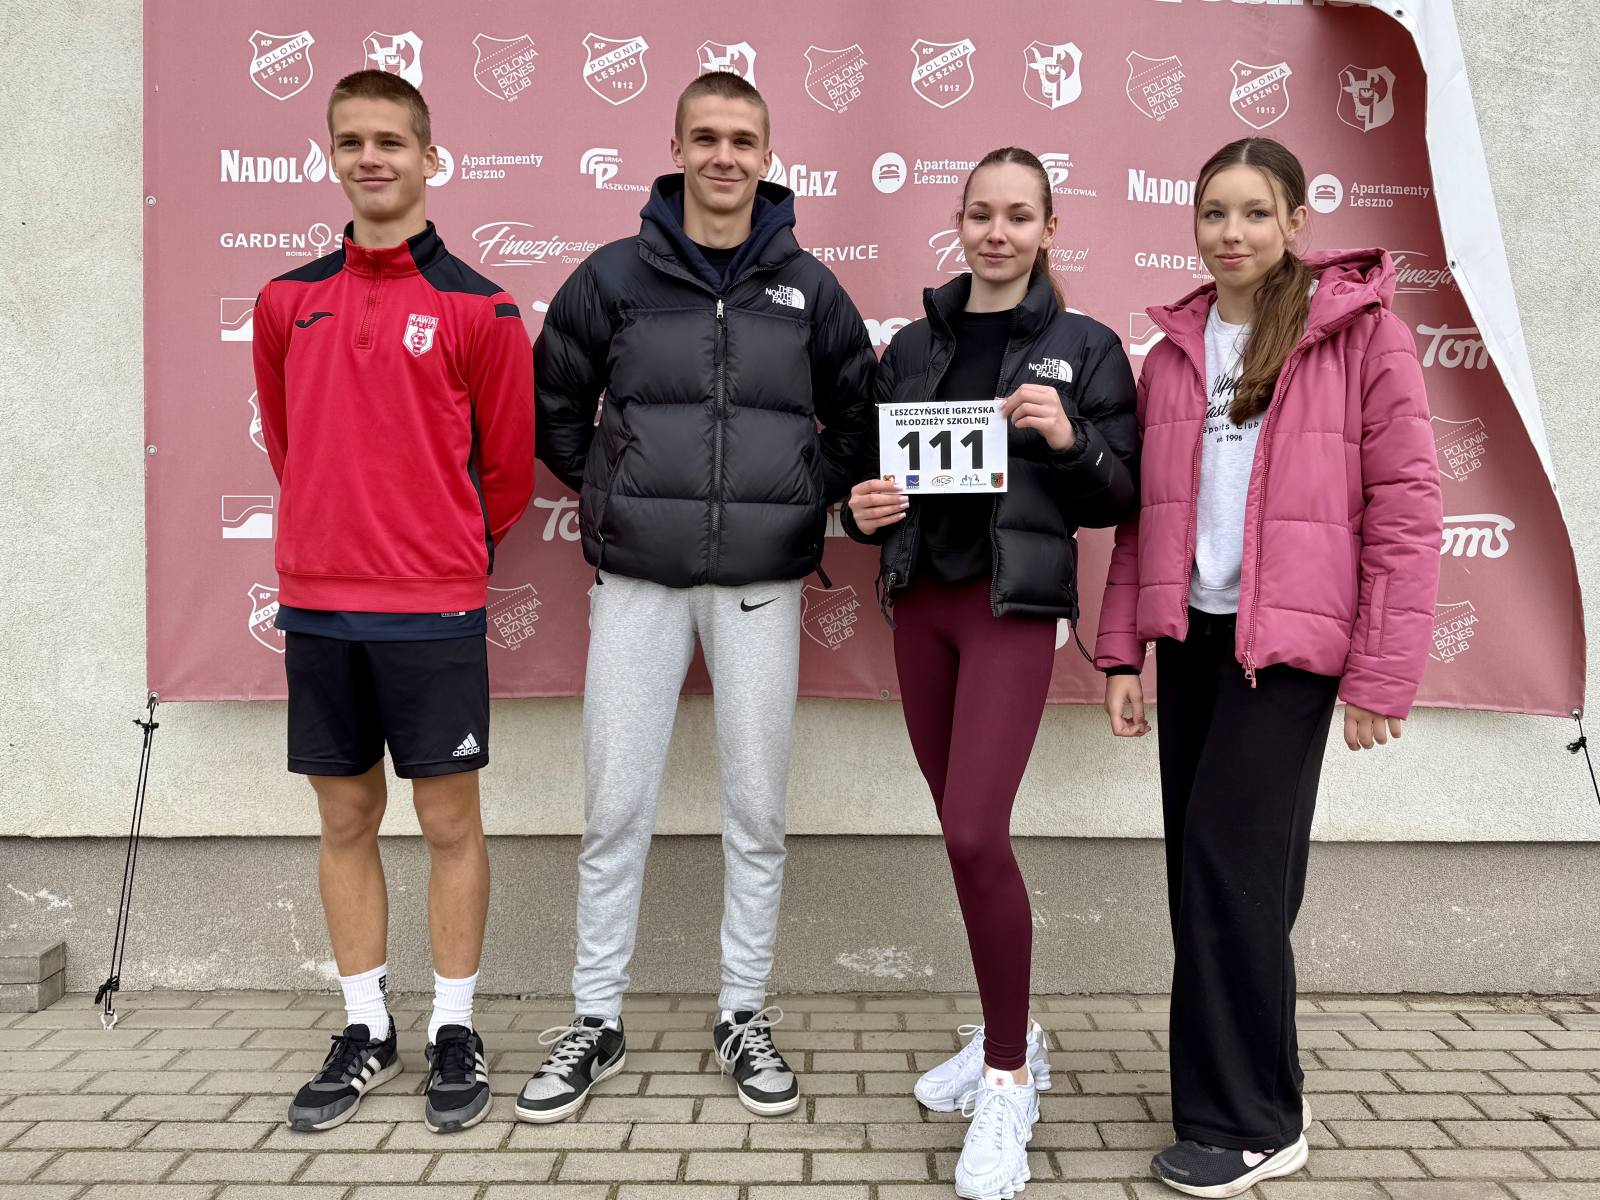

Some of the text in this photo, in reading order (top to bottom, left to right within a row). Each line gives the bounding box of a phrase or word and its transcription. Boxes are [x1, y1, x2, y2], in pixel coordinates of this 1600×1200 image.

[256, 36, 309, 69] POLONIA
[589, 41, 643, 72] POLONIA
[917, 44, 970, 77] POLONIA
[922, 47, 934, 55] KP
[260, 52, 303, 80] LESZNO
[491, 49, 539, 80] POLONIA
[594, 57, 636, 83] LESZNO
[822, 58, 868, 91] POLONIA
[921, 60, 964, 88] LESZNO
[1240, 69, 1252, 77] KP
[497, 62, 536, 89] BIZNES
[827, 71, 865, 101] BIZNES
[1142, 70, 1187, 97] POLONIA
[1235, 67, 1287, 98] POLONIA
[502, 76, 532, 99] KLUB
[832, 86, 862, 110] KLUB
[939, 84, 960, 92] 1912
[1146, 83, 1183, 108] BIZNES
[1239, 83, 1280, 109] LESZNO
[1151, 97, 1179, 118] KLUB
[1255, 106, 1276, 114] 1912
[220, 150, 303, 183] NADOL
[461, 154, 543, 168] Apartamenty
[914, 159, 980, 173] Apartame
[461, 168, 506, 180] Leszno
[790, 164, 838, 197] GAZ
[914, 173, 959, 185] Leszno
[1350, 182, 1430, 199] Apartamenty
[1350, 195, 1394, 208] Leszno
[220, 233, 305, 248] GARDEN
[561, 255, 584, 264] Toma
[803, 244, 879, 261] ERVICE
[1048, 247, 1089, 261] ring.pl
[765, 287, 793, 301] NORTH
[778, 284, 793, 294] THE
[772, 295, 793, 306] FACE
[410, 315, 437, 326] RAWIA
[1416, 324, 1490, 370] Tom
[1028, 362, 1059, 374] NORTH
[1042, 357, 1060, 366] THE
[1036, 370, 1059, 380] FACE
[890, 406, 995, 417] LESZCZYŃSKIE IGRZYSKA
[1205, 400, 1229, 419] ast
[895, 416, 989, 427] MŁODZIEŻY SZKOLNEJ
[897, 429, 984, 471] 111
[1443, 431, 1488, 459] POLONIA
[1448, 444, 1486, 469] BIZNES
[1453, 458, 1482, 478] KLUB
[1440, 513, 1516, 559] oms
[259, 592, 271, 600] KP
[493, 598, 543, 628] POLONIA
[818, 599, 861, 628] POLONIA
[499, 611, 539, 638] BIZNES
[822, 612, 858, 637] BIZNES
[1432, 614, 1480, 641] POLONIA
[504, 625, 536, 647] KLUB
[827, 626, 855, 647] KLUB
[1435, 627, 1475, 651] BIZNES
[1439, 640, 1470, 660] KLUB
[452, 745, 480, 757] adidas
